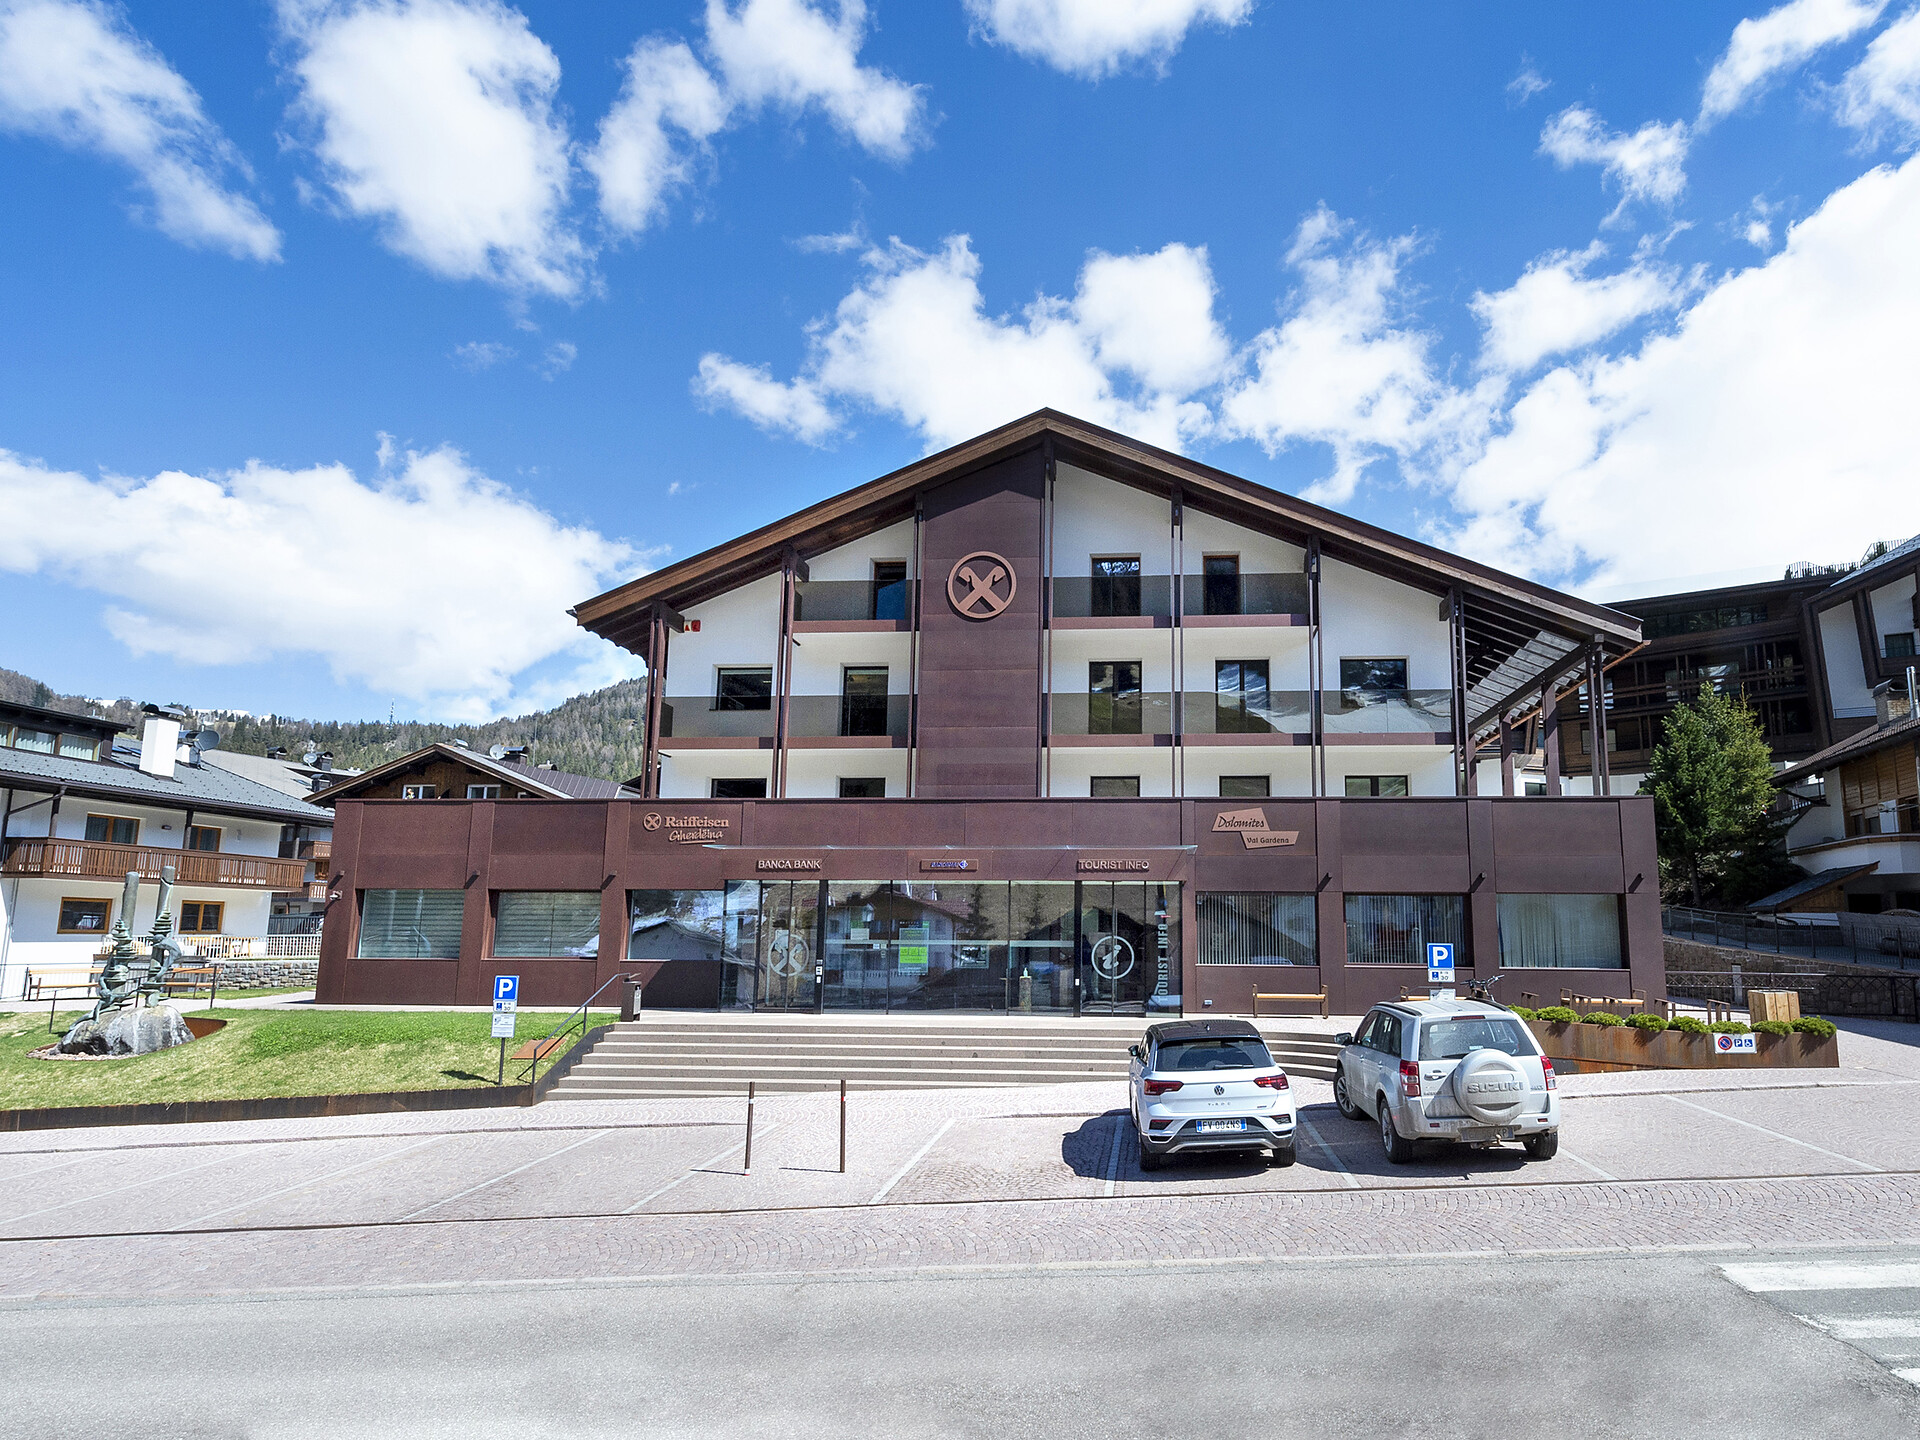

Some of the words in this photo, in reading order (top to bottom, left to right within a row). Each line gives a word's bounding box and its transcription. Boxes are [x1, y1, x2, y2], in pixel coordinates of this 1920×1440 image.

[664, 816, 729, 828] Raiffeisen
[1217, 815, 1265, 828] Dolomites
[668, 828, 723, 842] Gherdëina
[757, 859, 792, 870] BANCA
[794, 859, 821, 870] BANK
[1078, 860, 1123, 870] TOURIST
[1125, 860, 1150, 870] INFO
[1157, 923, 1169, 949] INFO
[1432, 946, 1448, 966] P
[498, 978, 513, 998] P
[1467, 1081, 1524, 1094] SUZUKI
